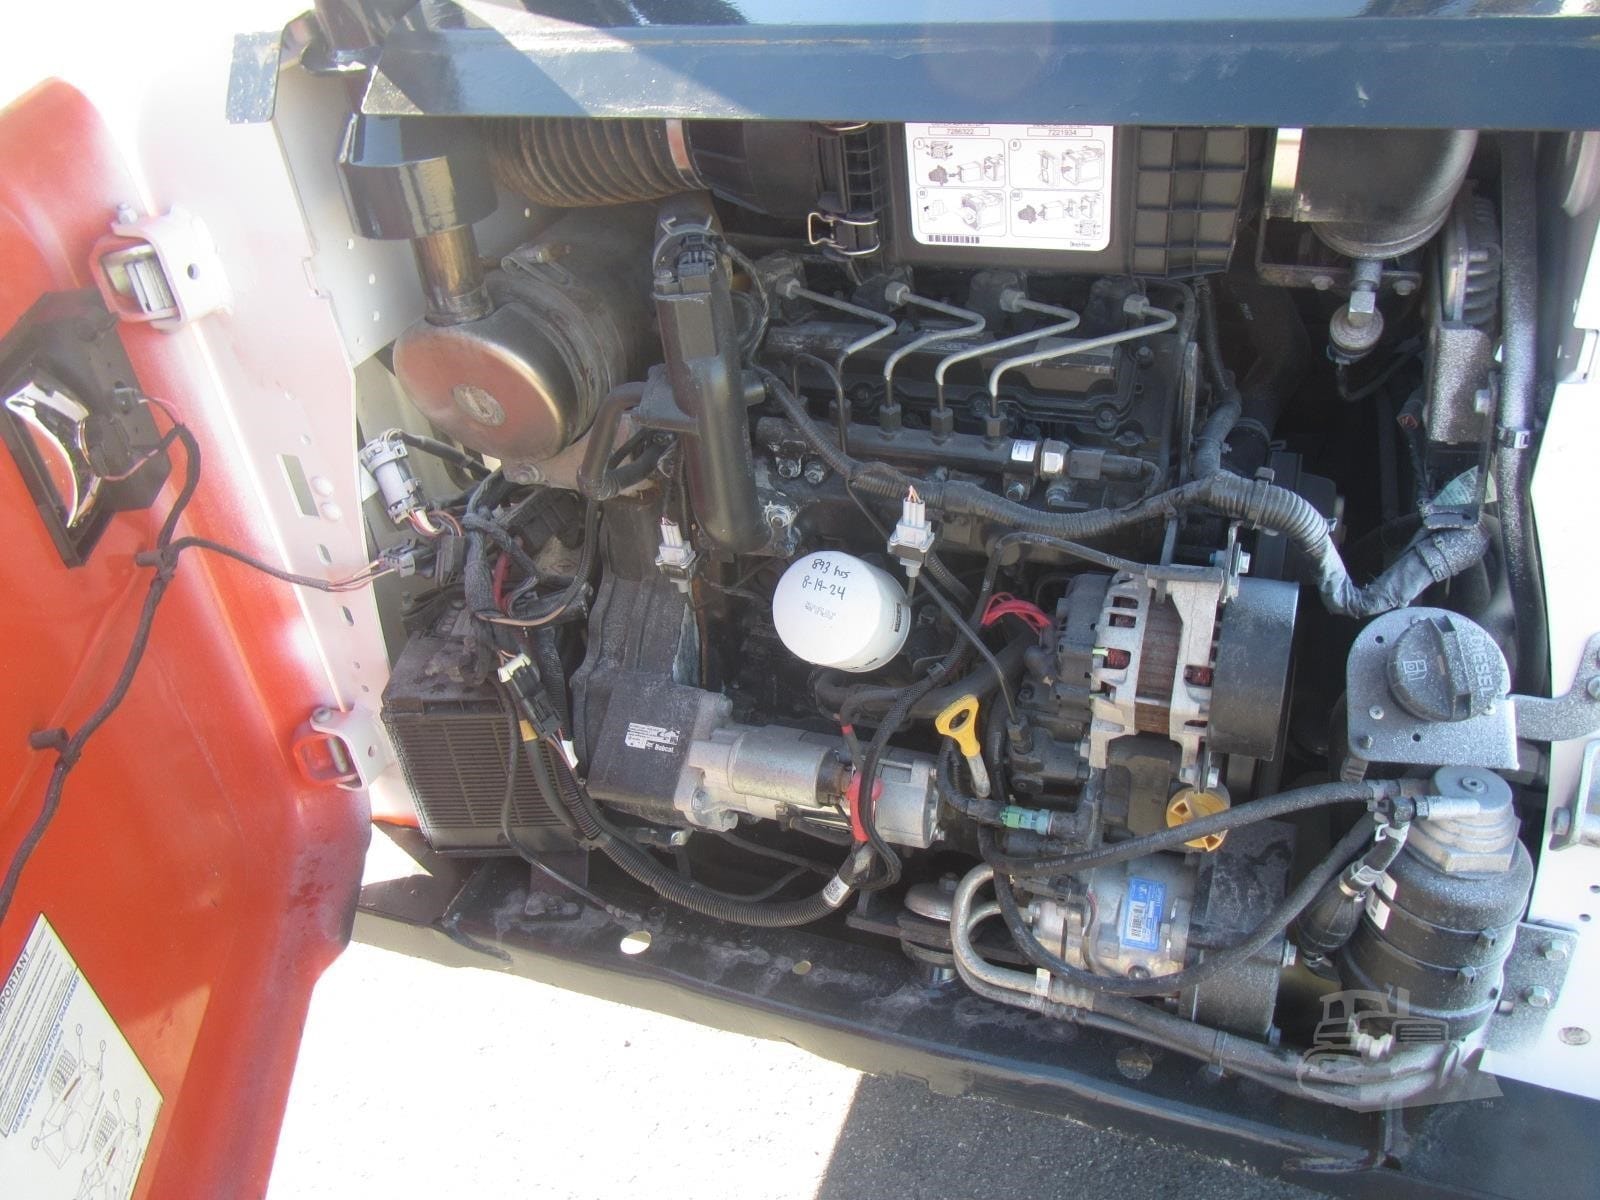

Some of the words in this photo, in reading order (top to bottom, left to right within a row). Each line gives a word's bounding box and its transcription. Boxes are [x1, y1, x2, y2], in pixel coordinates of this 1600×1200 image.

[811, 558, 831, 574] 893
[833, 565, 852, 579] hrs
[1470, 635, 1494, 697] DIESEL
[654, 743, 674, 754] Bobcat
[0, 948, 30, 1014] MPORTANT
[12, 1087, 34, 1134] GENERAL
[32, 1023, 61, 1086] LUBRICATION
[58, 975, 80, 1022] DIAGRAMS
